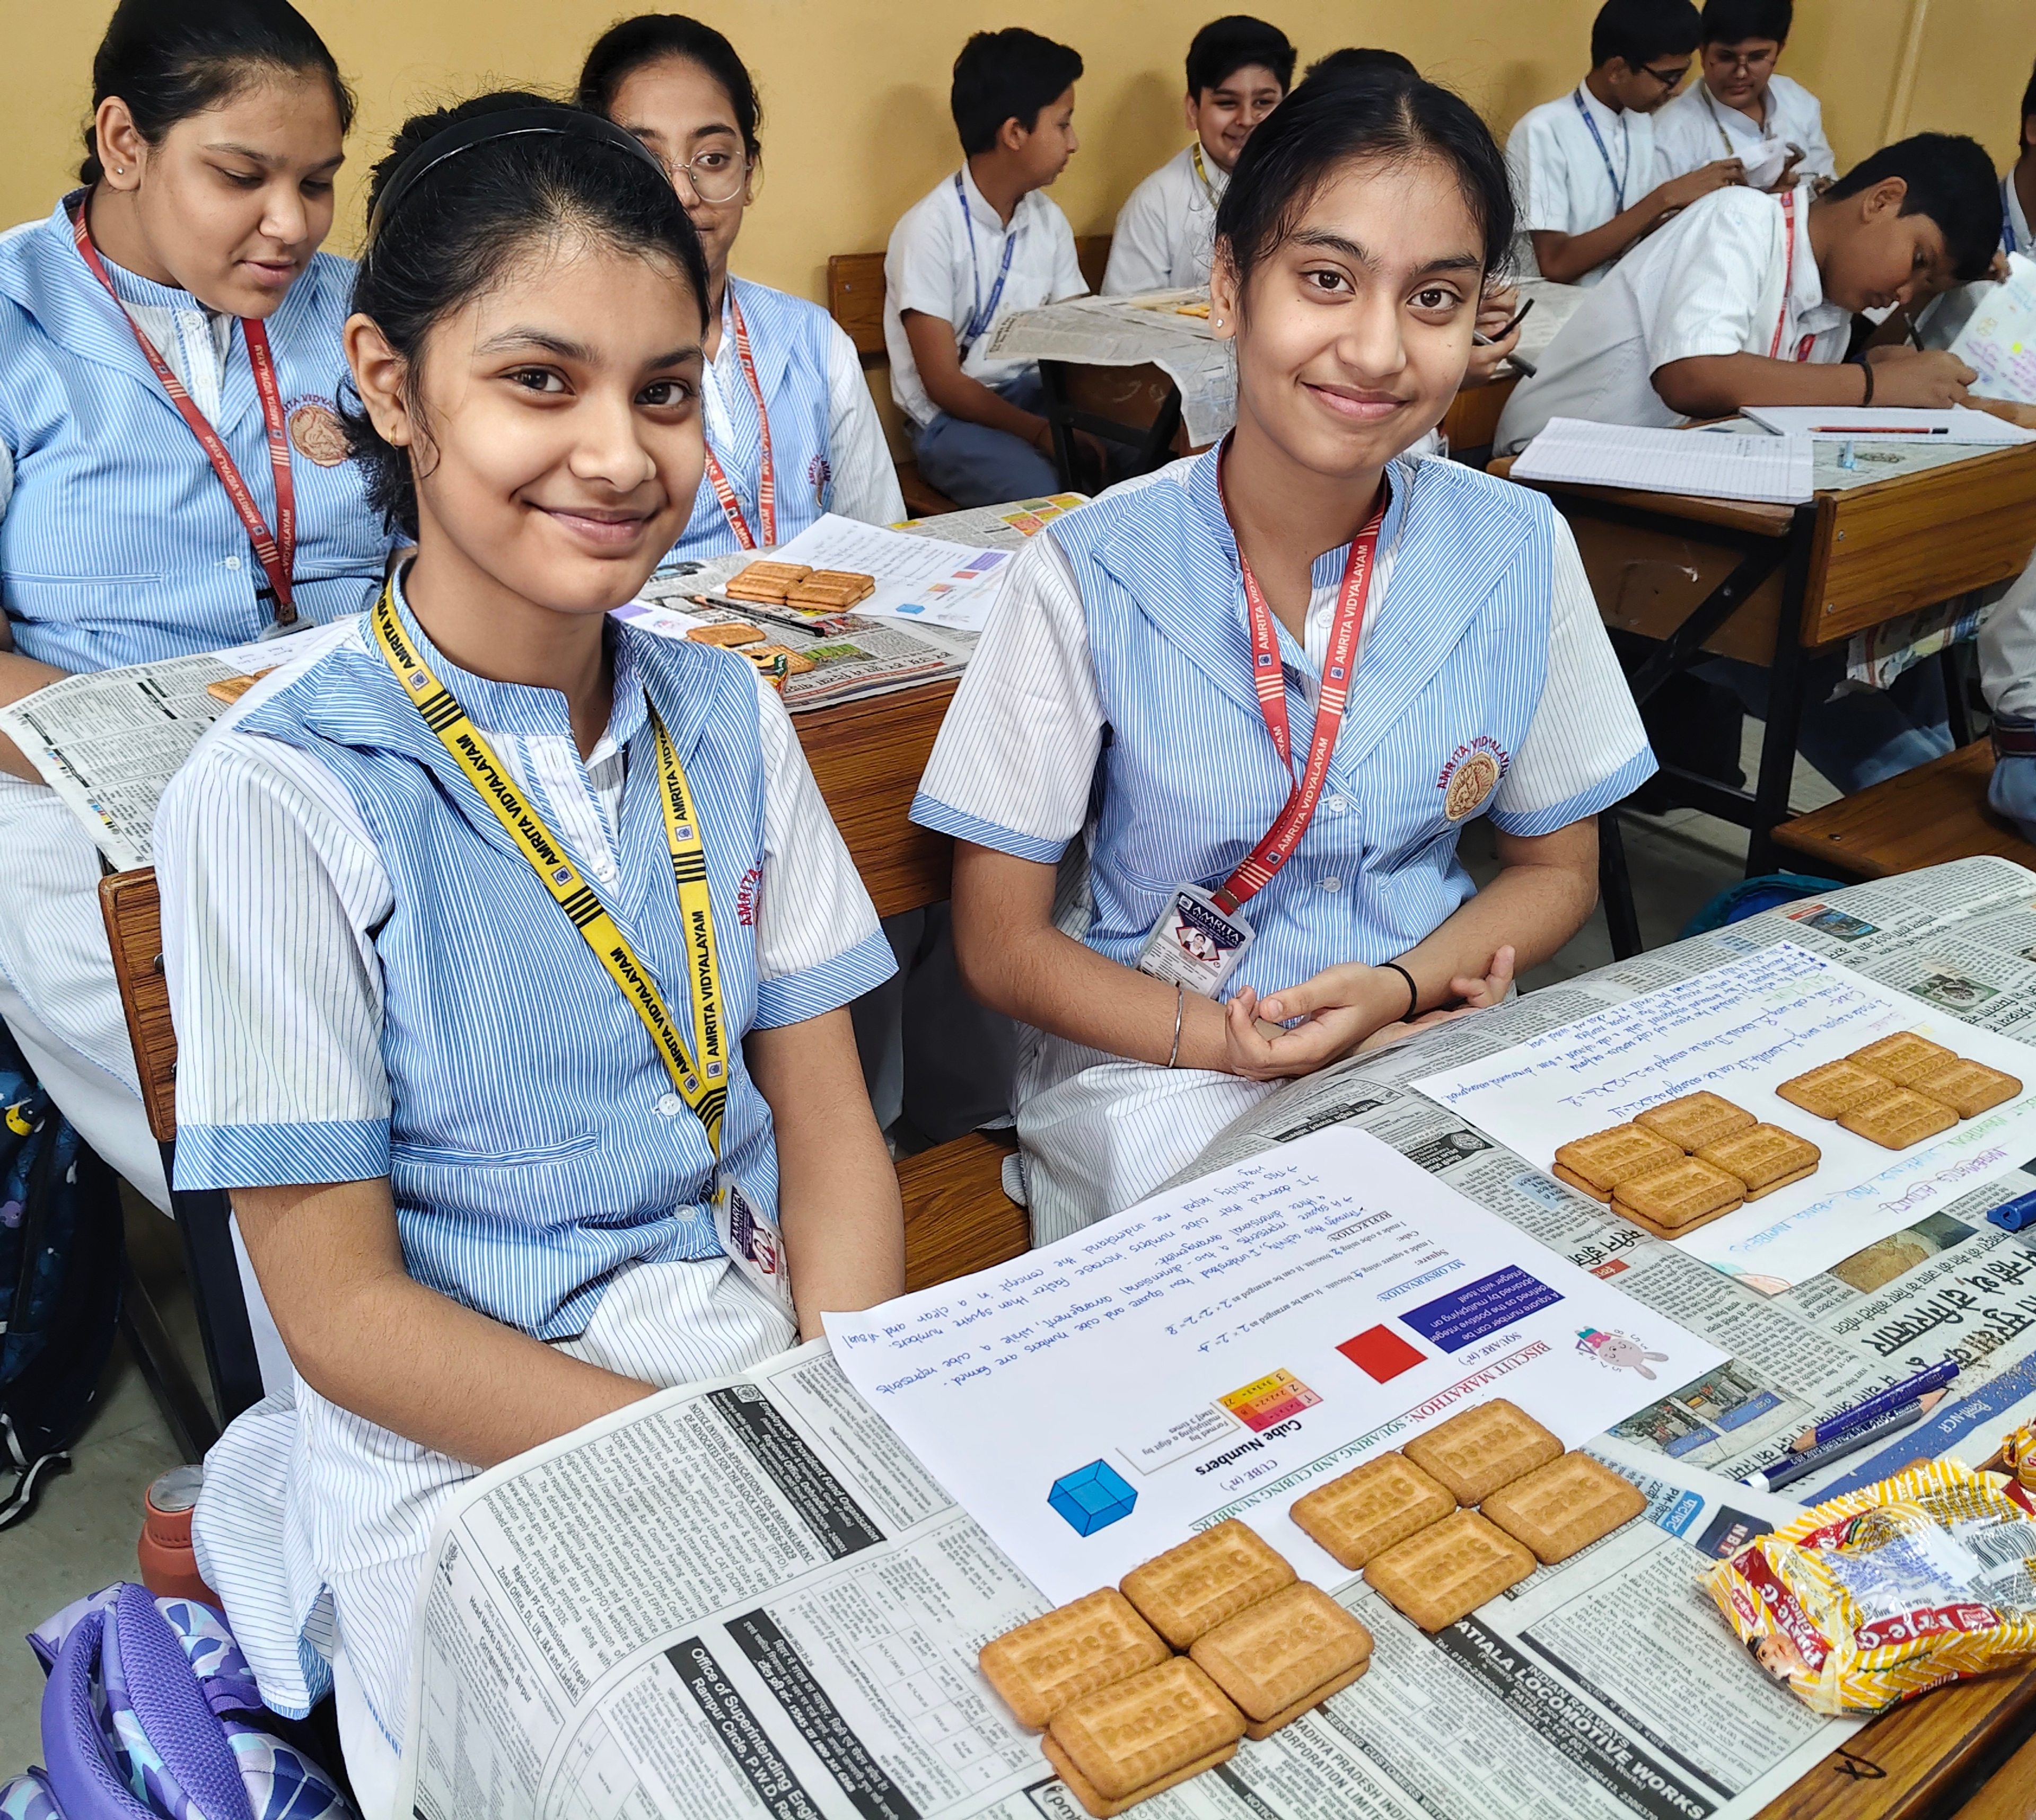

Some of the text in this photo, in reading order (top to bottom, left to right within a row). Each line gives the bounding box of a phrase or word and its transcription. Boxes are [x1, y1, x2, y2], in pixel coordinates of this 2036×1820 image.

[253, 343, 282, 429] AMRITA VIDYALAYAM
[1335, 542, 1375, 664] AMRITA VIDYALAYAM
[1253, 605, 1270, 651] AMRITA
[378, 617, 417, 672] AMRITA
[1438, 745, 1470, 790] AMRITA
[456, 732, 561, 869] AMRITA VIDYALAYAM
[665, 769, 689, 823] AMRITA
[1278, 737, 1329, 854] AMRITA VIDYALAYAM
[1193, 906, 1242, 942] AMRITA
[692, 911, 720, 1058] AMRITA VIDYALAYAM
[610, 947, 690, 1074] AMRITA VIDYALAYAM
[1152, 1212, 1171, 1222] me
[1331, 1211, 1392, 1240] REFLECTION:
[1081, 1223, 1146, 1254] understand
[1396, 1231, 1419, 1242] Cube:
[1409, 1242, 1428, 1252] made
[1053, 1257, 1077, 1267] the
[1361, 1263, 1382, 1273] using
[1381, 1252, 1405, 1264] square
[998, 1269, 1044, 1292] concept
[1170, 1278, 1192, 1289] how
[1377, 1259, 1465, 1303] MY OBSERVATION:
[1458, 1265, 1523, 1303] integer with itself
[1300, 1293, 1314, 1302] can
[1430, 1274, 1535, 1327] obtained by multiplying an
[1489, 1303, 1507, 1315] the
[1504, 1297, 1516, 1308] as
[1523, 1295, 1552, 1311] square
[917, 1307, 949, 1322] clear
[1074, 1318, 1100, 1331] cube
[1103, 1307, 1125, 1321] and
[1259, 1304, 1291, 1324] arranged
[1459, 1308, 1491, 1328] positive
[1473, 1322, 1492, 1335] can
[1491, 1308, 1524, 1326] number
[882, 1323, 906, 1337] and
[1024, 1332, 1069, 1353] numbers
[1429, 1325, 1460, 1344] integer
[1460, 1330, 1476, 1341] be
[1478, 1333, 1522, 1355] SQUARE
[995, 1354, 1017, 1366] are
[689, 1401, 712, 1427] NOTICE
[1169, 1422, 1190, 1434] times
[1178, 1411, 1222, 1440] multiplying
[1195, 1406, 1214, 1422] itself
[1201, 1418, 1228, 1437] Formed
[1154, 1439, 1173, 1450] digit
[1192, 1342, 1552, 1538] BISCUIT MARATHON: SQUARING AND CUBING NUMBERS
[1195, 1420, 1302, 1475] Cube Numbers
[726, 1449, 766, 1498] APPLICATIONS
[759, 1400, 882, 1545] Employees' Provident Fund Organisation
[759, 1431, 788, 1463] Regional
[798, 1478, 831, 1516] Dehradun
[1243, 1459, 1278, 1480] CUBE
[761, 1493, 776, 1512] FOR
[768, 1508, 817, 1566] EMPANELMENT
[1715, 1519, 1752, 1555] NBT
[512, 1565, 534, 1597] Regional
[530, 1595, 541, 1605] PF
[569, 1660, 594, 1691] (Legal)
[1749, 1578, 1831, 1669] Parle-G
[688, 1645, 796, 1795] Office of Superintending
[1452, 1615, 1517, 1673] ATIALA
[1513, 1663, 1634, 1769] LOCOMOTIVE
[1629, 1755, 1708, 1820] WORKS
[1528, 1661, 1631, 1751] INDIAN RAILWAYS
[1508, 1686, 1590, 1756] PATIALA-147 003
[692, 1675, 782, 1804] Rampur Circle, P.W.D.
[1323, 1707, 1423, 1804] SERVING CUSTOMERS
[1331, 1754, 1382, 1799] PRADESH
